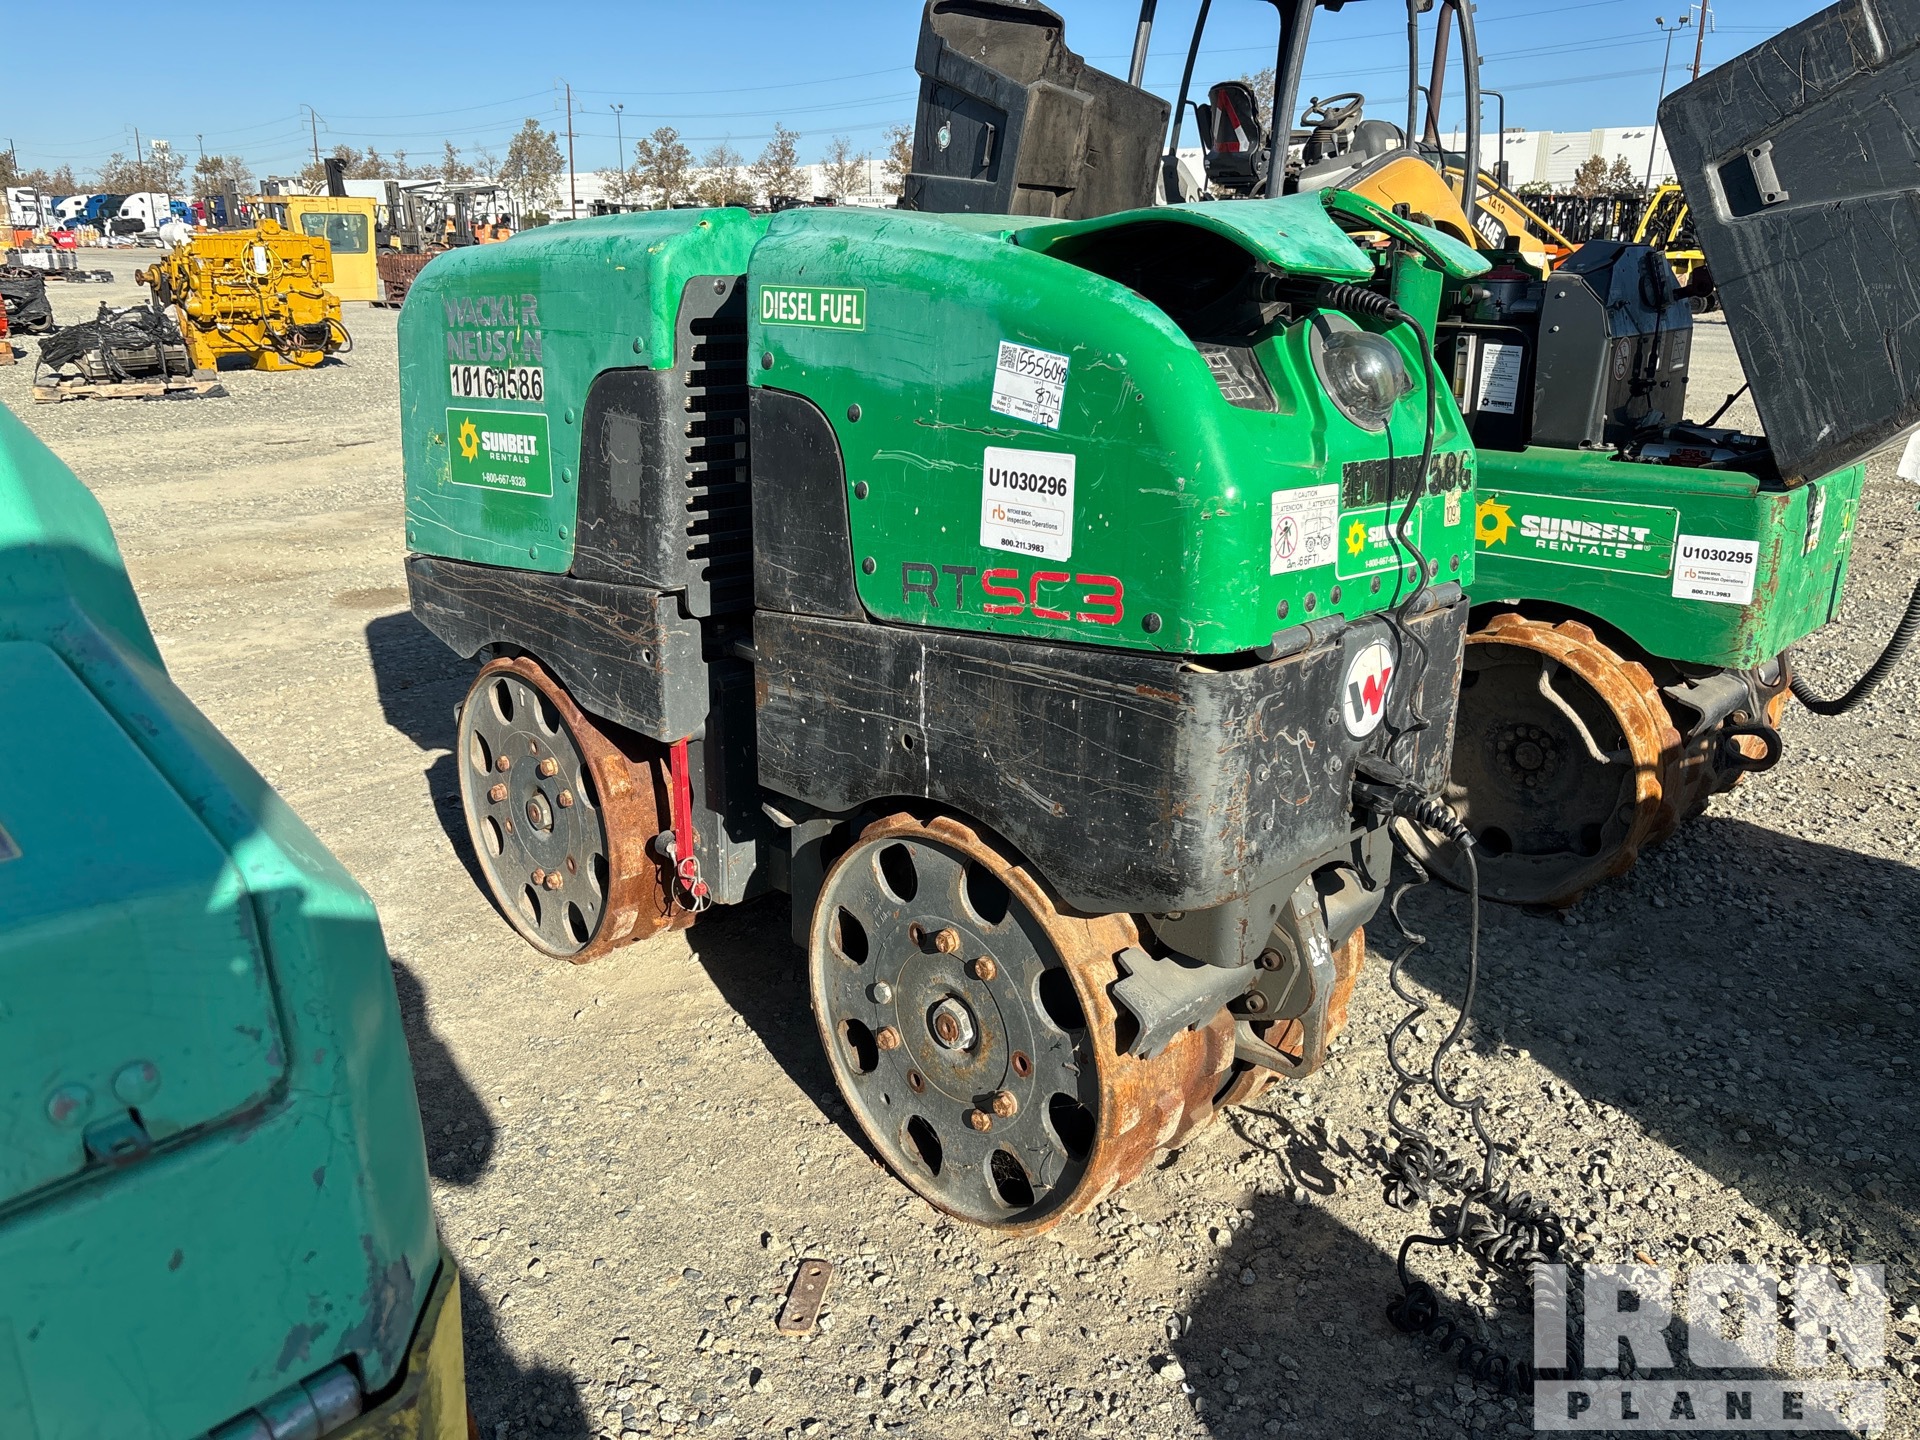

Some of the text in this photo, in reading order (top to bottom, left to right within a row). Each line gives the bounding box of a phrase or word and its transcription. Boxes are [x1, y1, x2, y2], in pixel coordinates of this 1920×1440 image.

[1476, 211, 1502, 247] 414E
[763, 290, 861, 324] DIESEL FUEL
[481, 431, 537, 456] SUNBELT
[489, 452, 530, 464] RENTALS
[481, 471, 527, 488] 1-800-667-9328
[989, 467, 1067, 497] U1030296
[1298, 490, 1318, 499] CAUTION
[1007, 517, 1058, 531] Inspection Operations
[1520, 514, 1650, 551] SUNBELT
[1001, 538, 1045, 553] 800.211.3983
[1535, 539, 1627, 559] RENTALS
[1682, 546, 1753, 564] U1030295
[1720, 577, 1743, 585] Operations
[902, 561, 1124, 625] RTSC3
[1691, 588, 1731, 598] 800.211.3983
